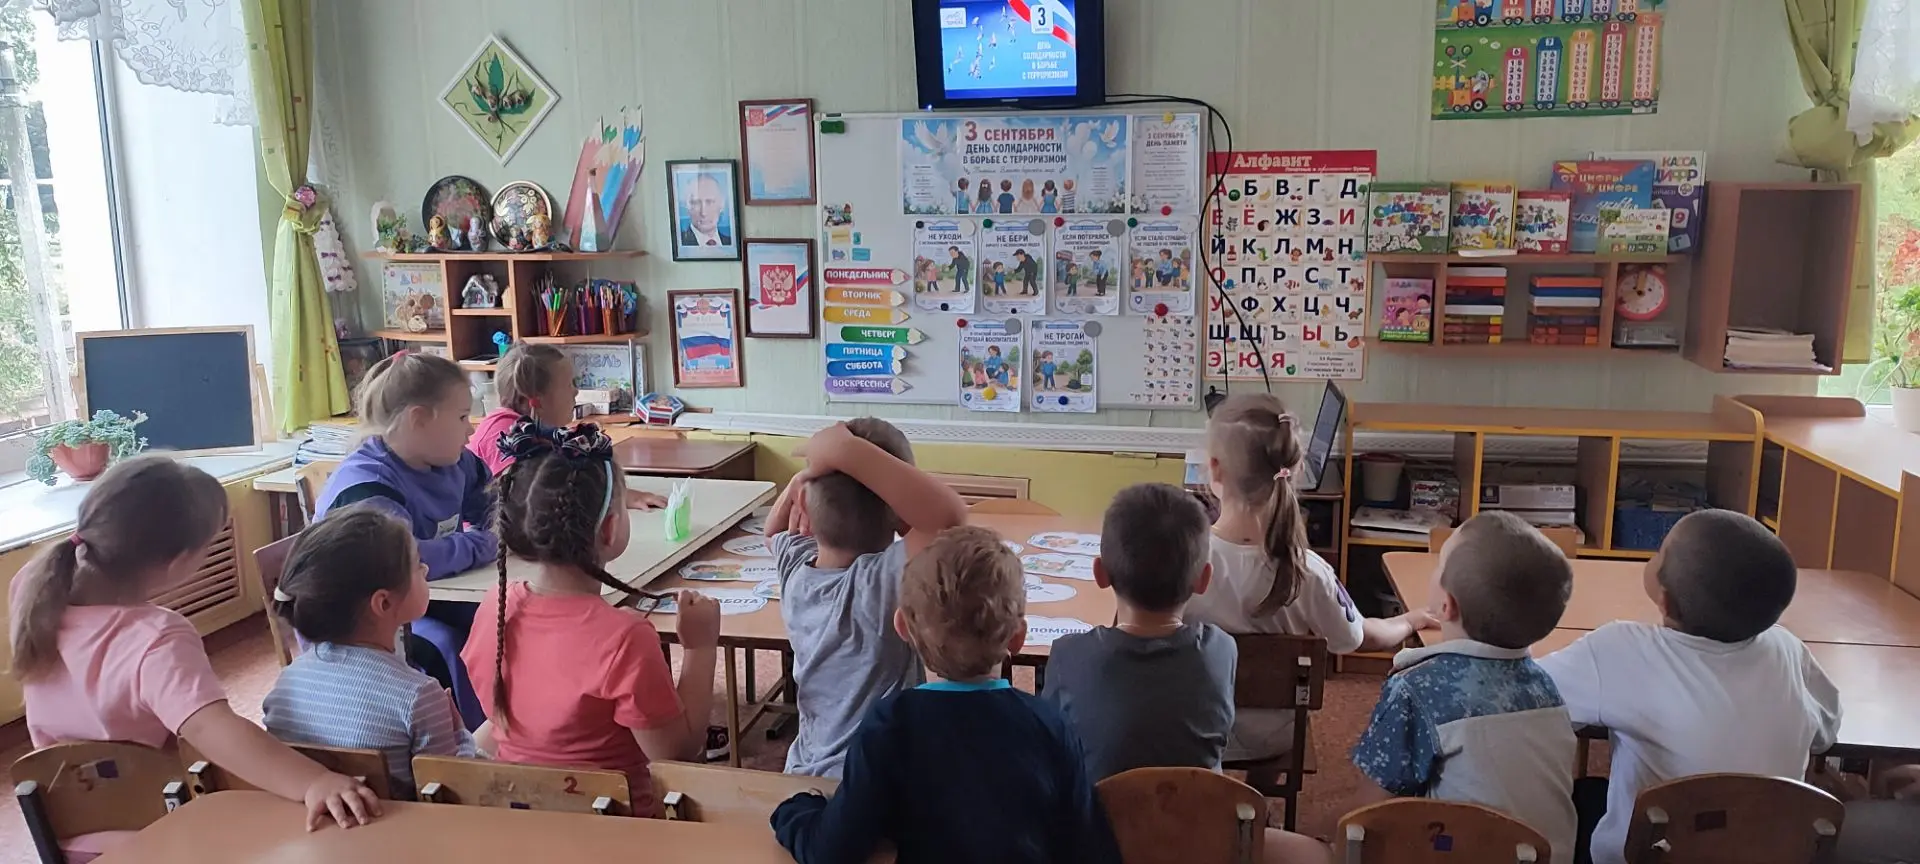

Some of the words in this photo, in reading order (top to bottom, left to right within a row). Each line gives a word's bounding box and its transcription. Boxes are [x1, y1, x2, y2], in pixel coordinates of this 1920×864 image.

[1038, 8, 1046, 26] 3
[965, 121, 978, 141] 3
[984, 128, 1054, 140] СЕНТЯБРЯ
[966, 143, 990, 154] ДЕНЬ
[993, 142, 1062, 154] СОЛИДАРНОСТИ
[963, 156, 968, 164] В
[970, 156, 1000, 164] БОРЬБЕ
[1003, 156, 1008, 164] С
[1010, 155, 1067, 164] ТЕРРОРИЗМОМ
[1234, 154, 1312, 170] Алфавит
[1662, 157, 1697, 166] КАССА
[1580, 174, 1623, 182] ЦИФРЫ
[1212, 181, 1227, 196] А
[1244, 180, 1257, 196] Б
[1276, 180, 1289, 195] В
[1309, 180, 1320, 195] Г
[1340, 179, 1357, 198] Д
[1599, 184, 1638, 192] ЦИФРЕ
[1212, 210, 1223, 225] Е
[1244, 204, 1255, 225] Ё
[1276, 209, 1298, 225] Ж
[1307, 209, 1320, 225] З
[1340, 209, 1354, 225] И
[1675, 212, 1686, 223] 9
[1212, 235, 1225, 254] Й
[1243, 239, 1256, 254] К
[1274, 239, 1290, 254] Л
[1307, 239, 1323, 254] М
[1338, 238, 1353, 254] Н
[826, 270, 889, 279] ПОНЕДЕЛЬНИК
[1212, 268, 1226, 283] О
[1242, 268, 1255, 283] П
[1274, 268, 1285, 283] Р
[1305, 268, 1319, 283] С
[1337, 268, 1351, 283] Т
[842, 290, 881, 299] ВТОРНИК
[1211, 296, 1222, 311] У
[1241, 296, 1259, 312] Ф
[1272, 297, 1286, 312] Х
[1304, 297, 1319, 315] Ц
[1336, 297, 1349, 312] Ч
[844, 310, 871, 318] СРЕДА
[861, 330, 896, 338] ЧЕТВЕРГ
[1056, 332, 1084, 340] ТРОГАЙ
[1210, 325, 1229, 340] Ш
[1240, 325, 1261, 343] Щ
[1271, 326, 1286, 341] Ъ
[1303, 325, 1321, 341] Ы
[1335, 326, 1348, 341] Ь
[843, 347, 883, 356] ПЯТНИЦА
[1208, 352, 1221, 367] Э
[1239, 352, 1260, 368] Ю
[1271, 353, 1285, 368] Я
[846, 362, 882, 370] СУББОТА
[833, 380, 890, 388] ВОСКРЕСЕНЬЕ
[564, 776, 584, 796] 2
